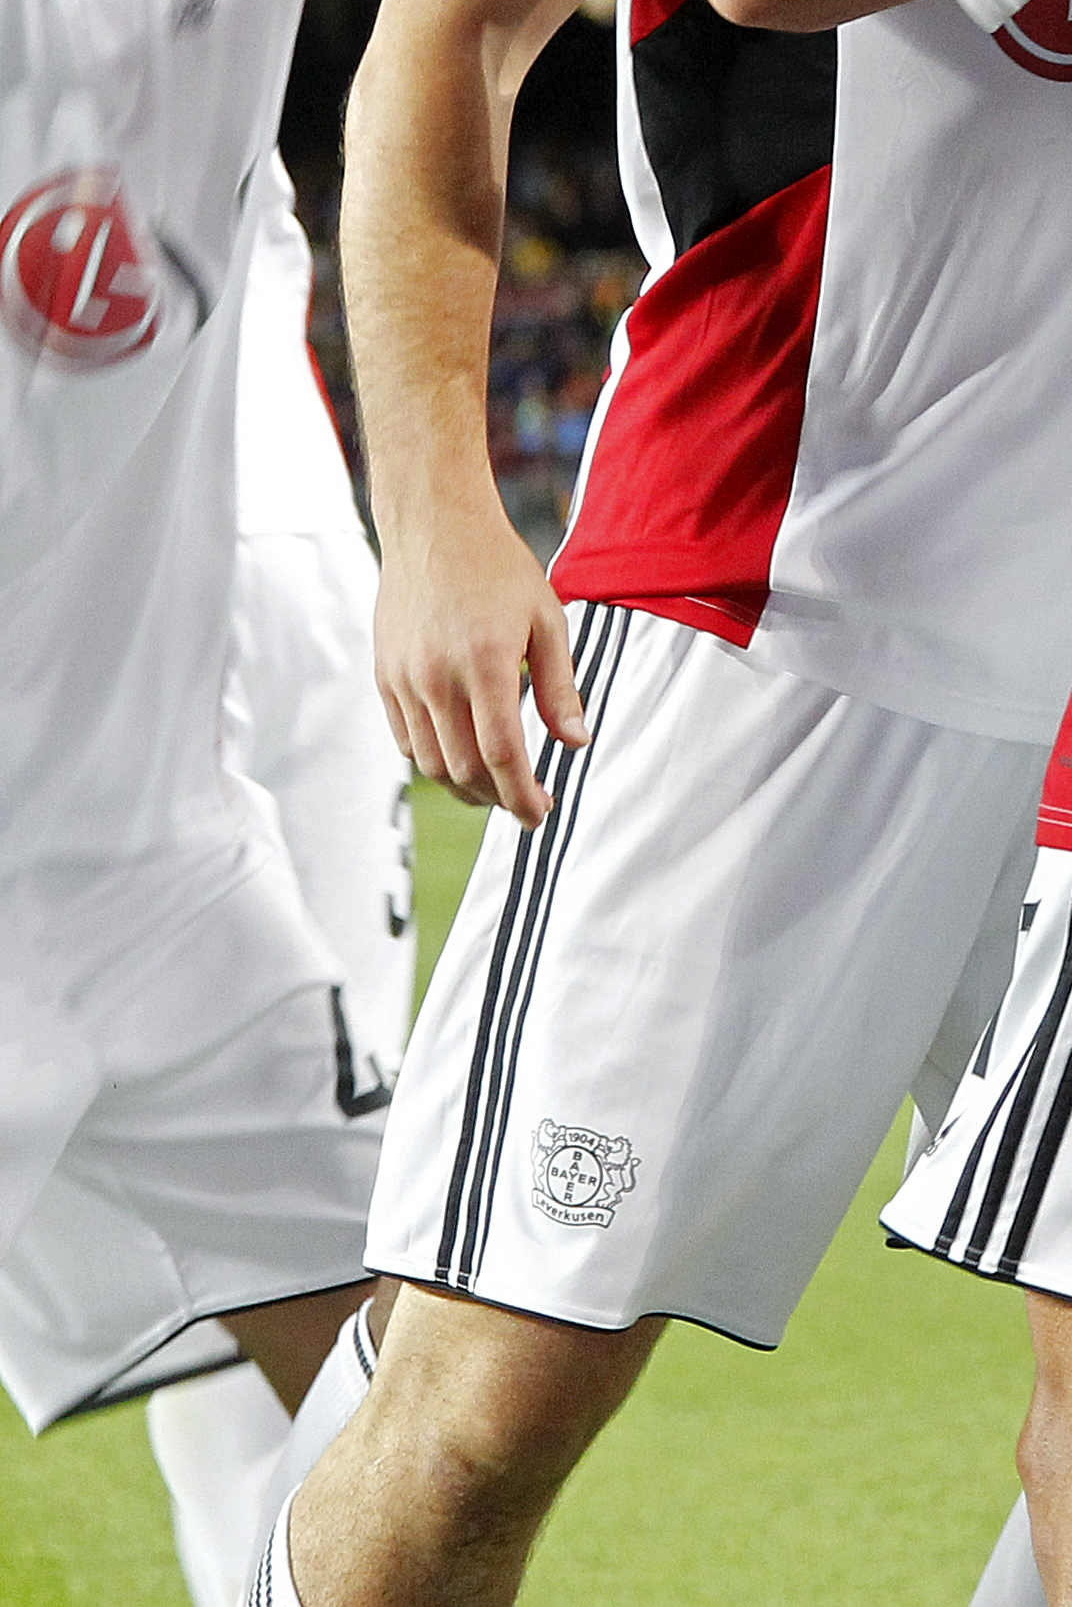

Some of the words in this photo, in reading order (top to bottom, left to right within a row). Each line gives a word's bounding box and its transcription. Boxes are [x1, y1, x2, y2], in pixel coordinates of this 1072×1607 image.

[569, 1133, 595, 1147] 1904
[551, 1168, 597, 1186] BAYER
[536, 1195, 604, 1222] Leverkusen
